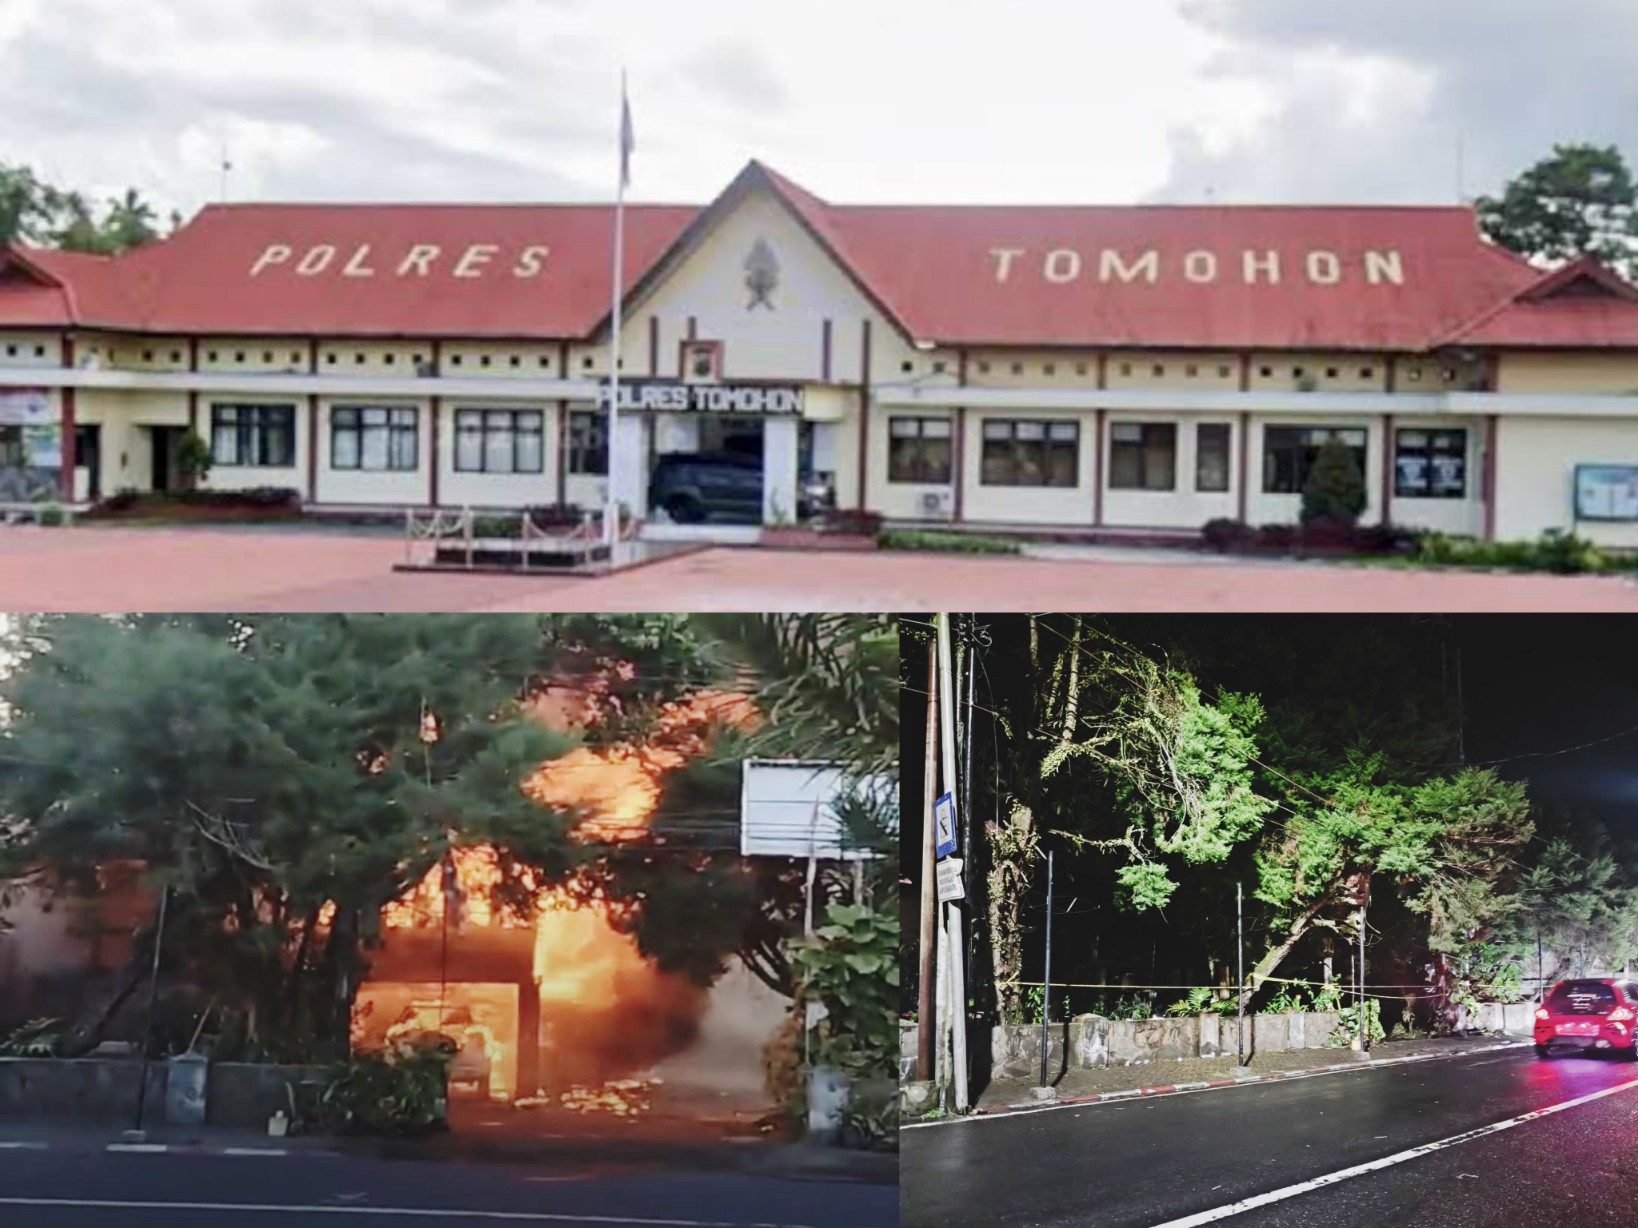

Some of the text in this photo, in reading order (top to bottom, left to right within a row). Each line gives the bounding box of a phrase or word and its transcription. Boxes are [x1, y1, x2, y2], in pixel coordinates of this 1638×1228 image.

[250, 244, 1404, 285] POLRES TOMOHON
[597, 384, 804, 412] POLRES TOMOHON
